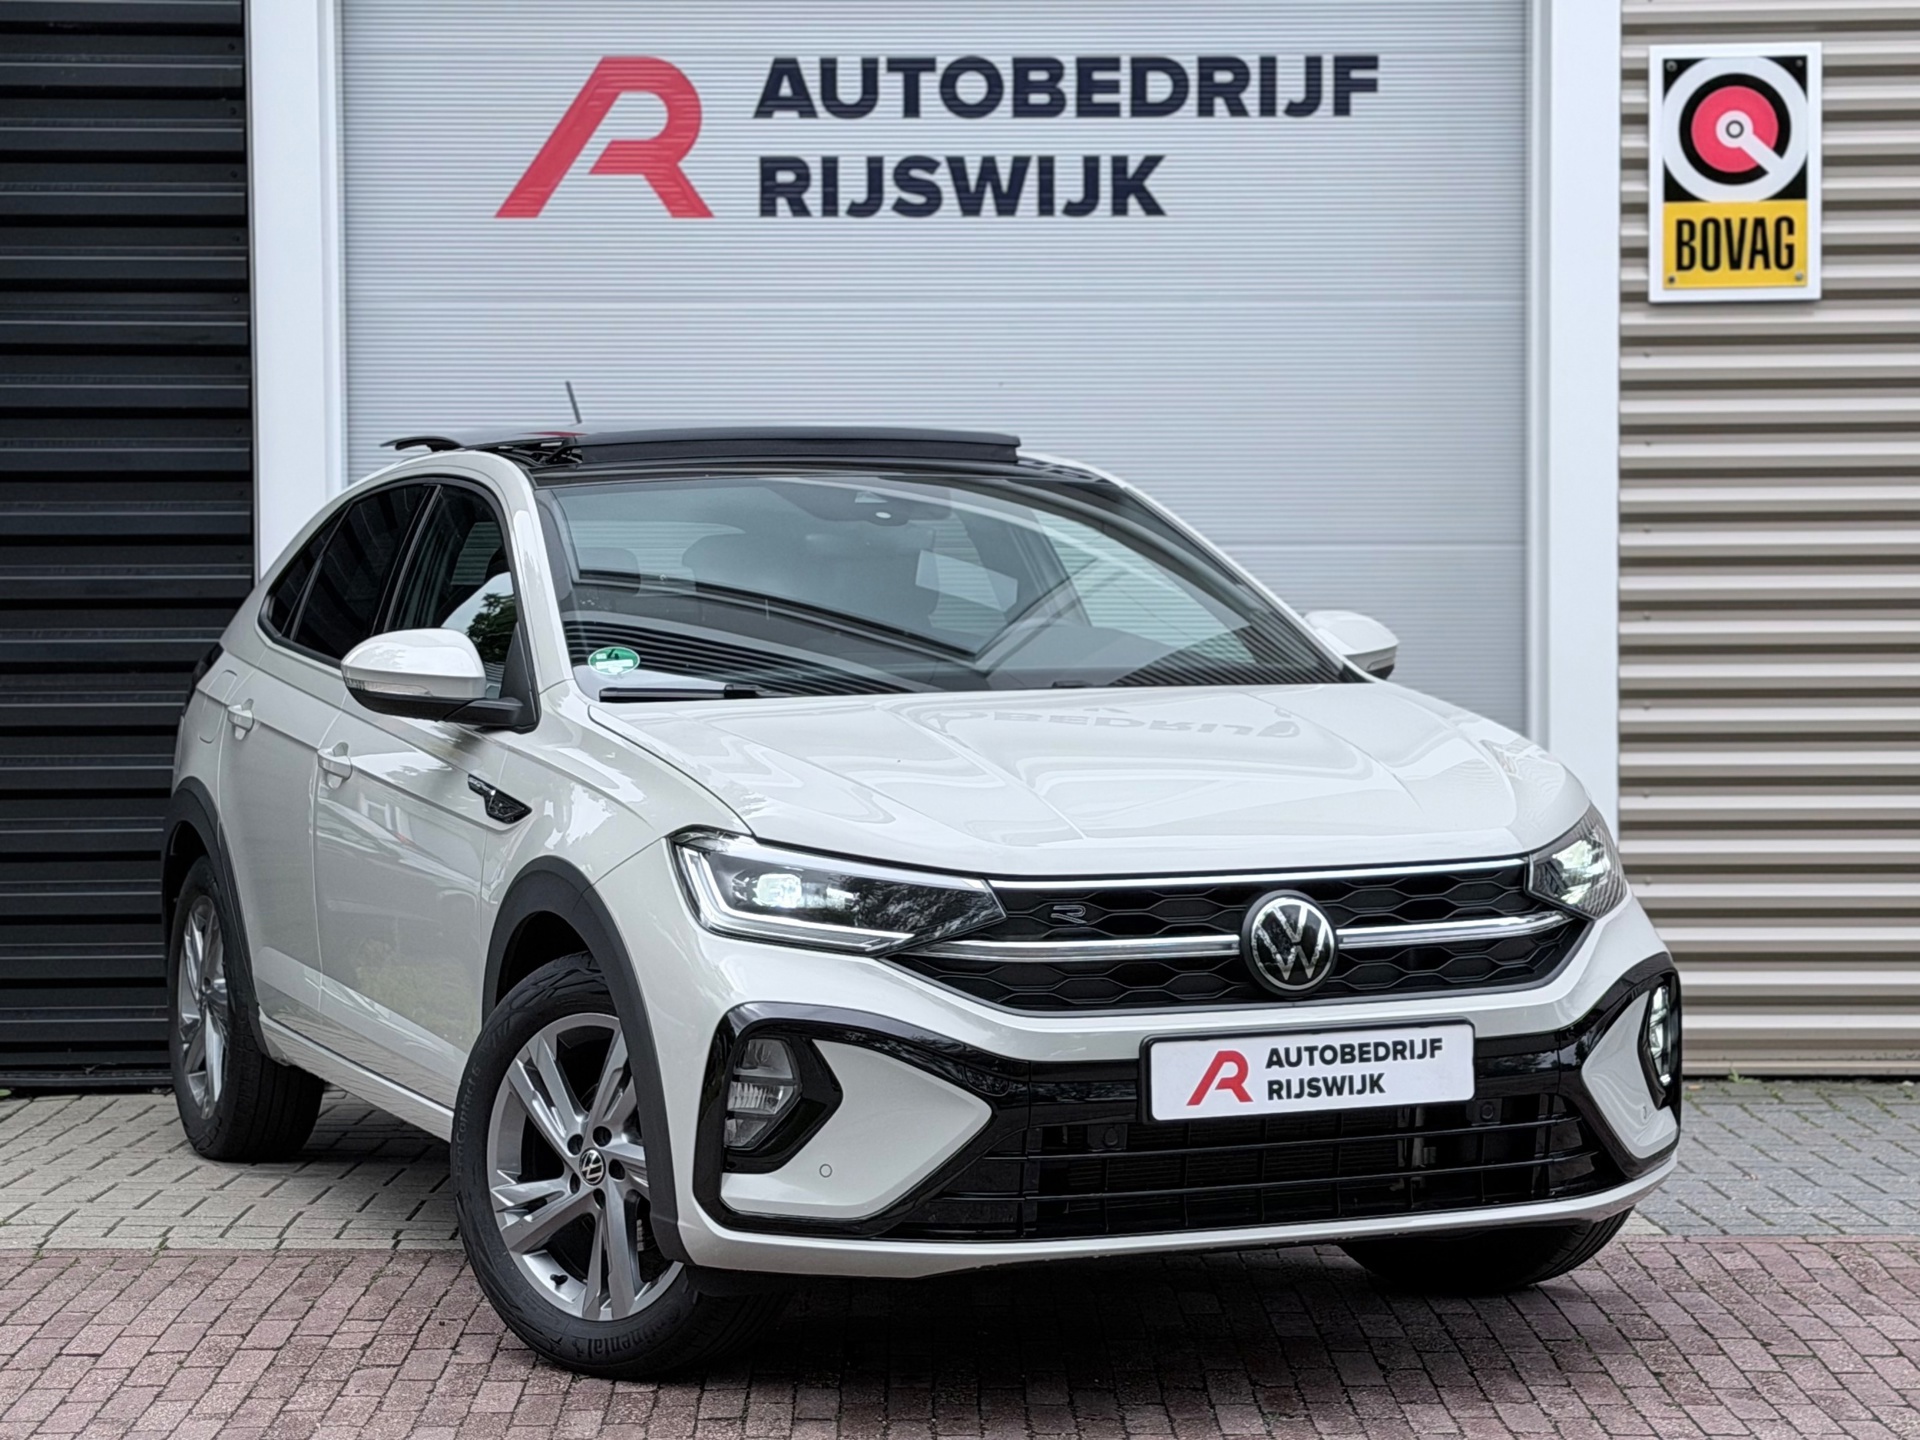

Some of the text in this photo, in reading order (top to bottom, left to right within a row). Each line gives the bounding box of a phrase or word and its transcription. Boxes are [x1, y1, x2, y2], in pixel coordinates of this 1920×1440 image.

[754, 55, 1379, 119] AUTOBEDRIJF
[759, 155, 1167, 217] RIJSWIJK
[1676, 216, 1795, 272] BOVAG
[1250, 896, 1336, 992] VW
[1265, 1037, 1443, 1069] AUTOBEDRIJF
[1267, 1073, 1386, 1101] RIJSWIJK
